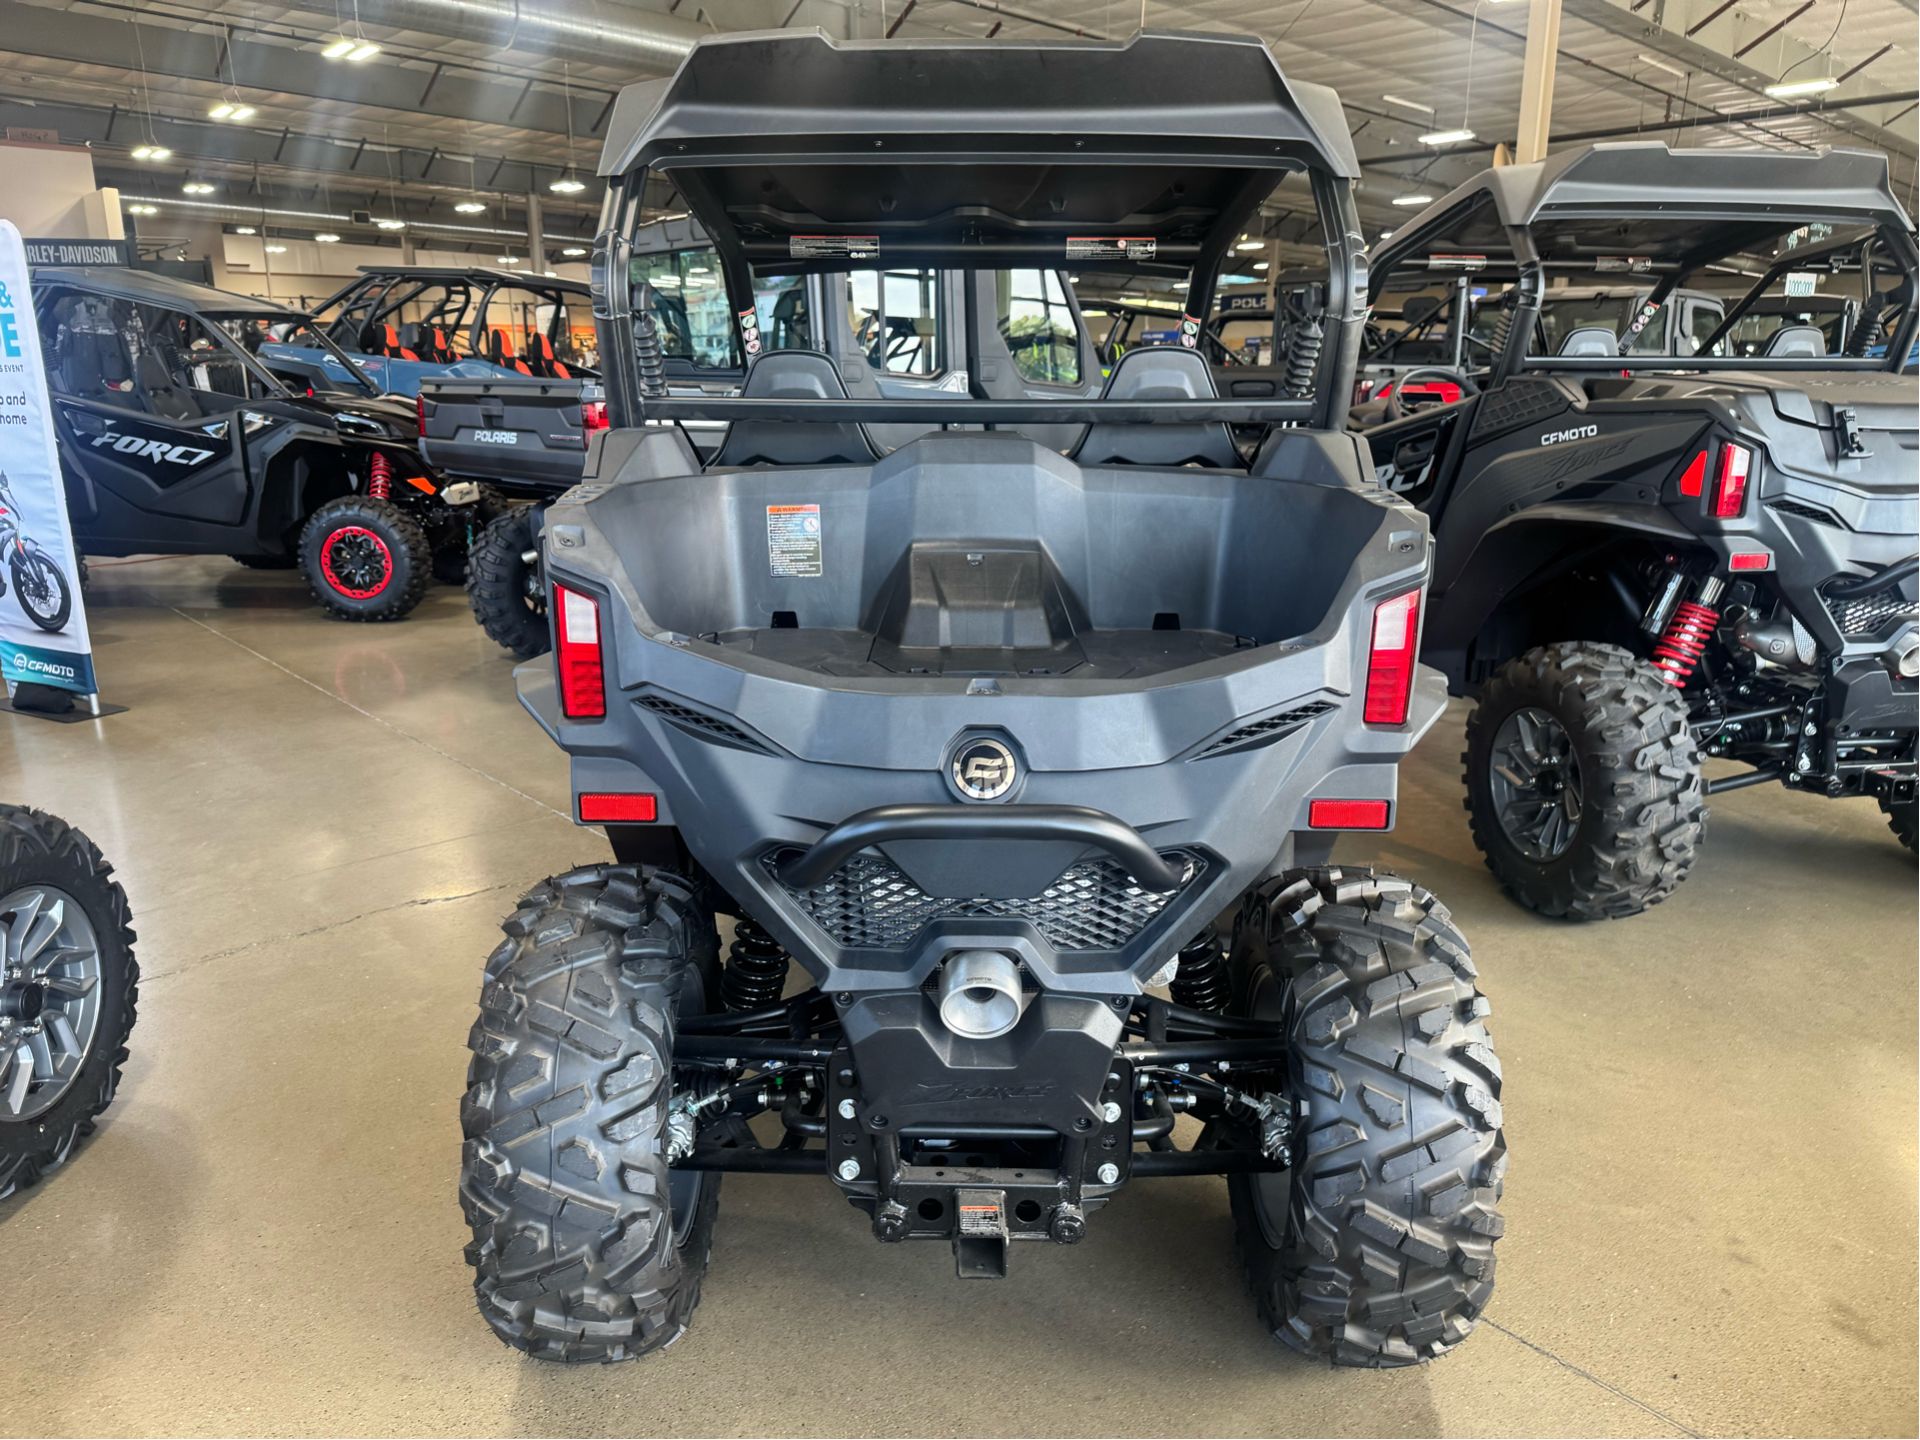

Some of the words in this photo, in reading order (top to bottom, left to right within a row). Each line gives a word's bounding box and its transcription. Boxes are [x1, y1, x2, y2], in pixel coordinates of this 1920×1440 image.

[25, 245, 117, 263] RLEY-DAVIDSON
[0, 313, 21, 357] E
[4, 364, 24, 373] EVENT
[6, 391, 26, 406] and
[474, 430, 518, 444] POLARIS
[1541, 424, 1598, 446] CFMOTO
[27, 660, 75, 678] CFMOTO
